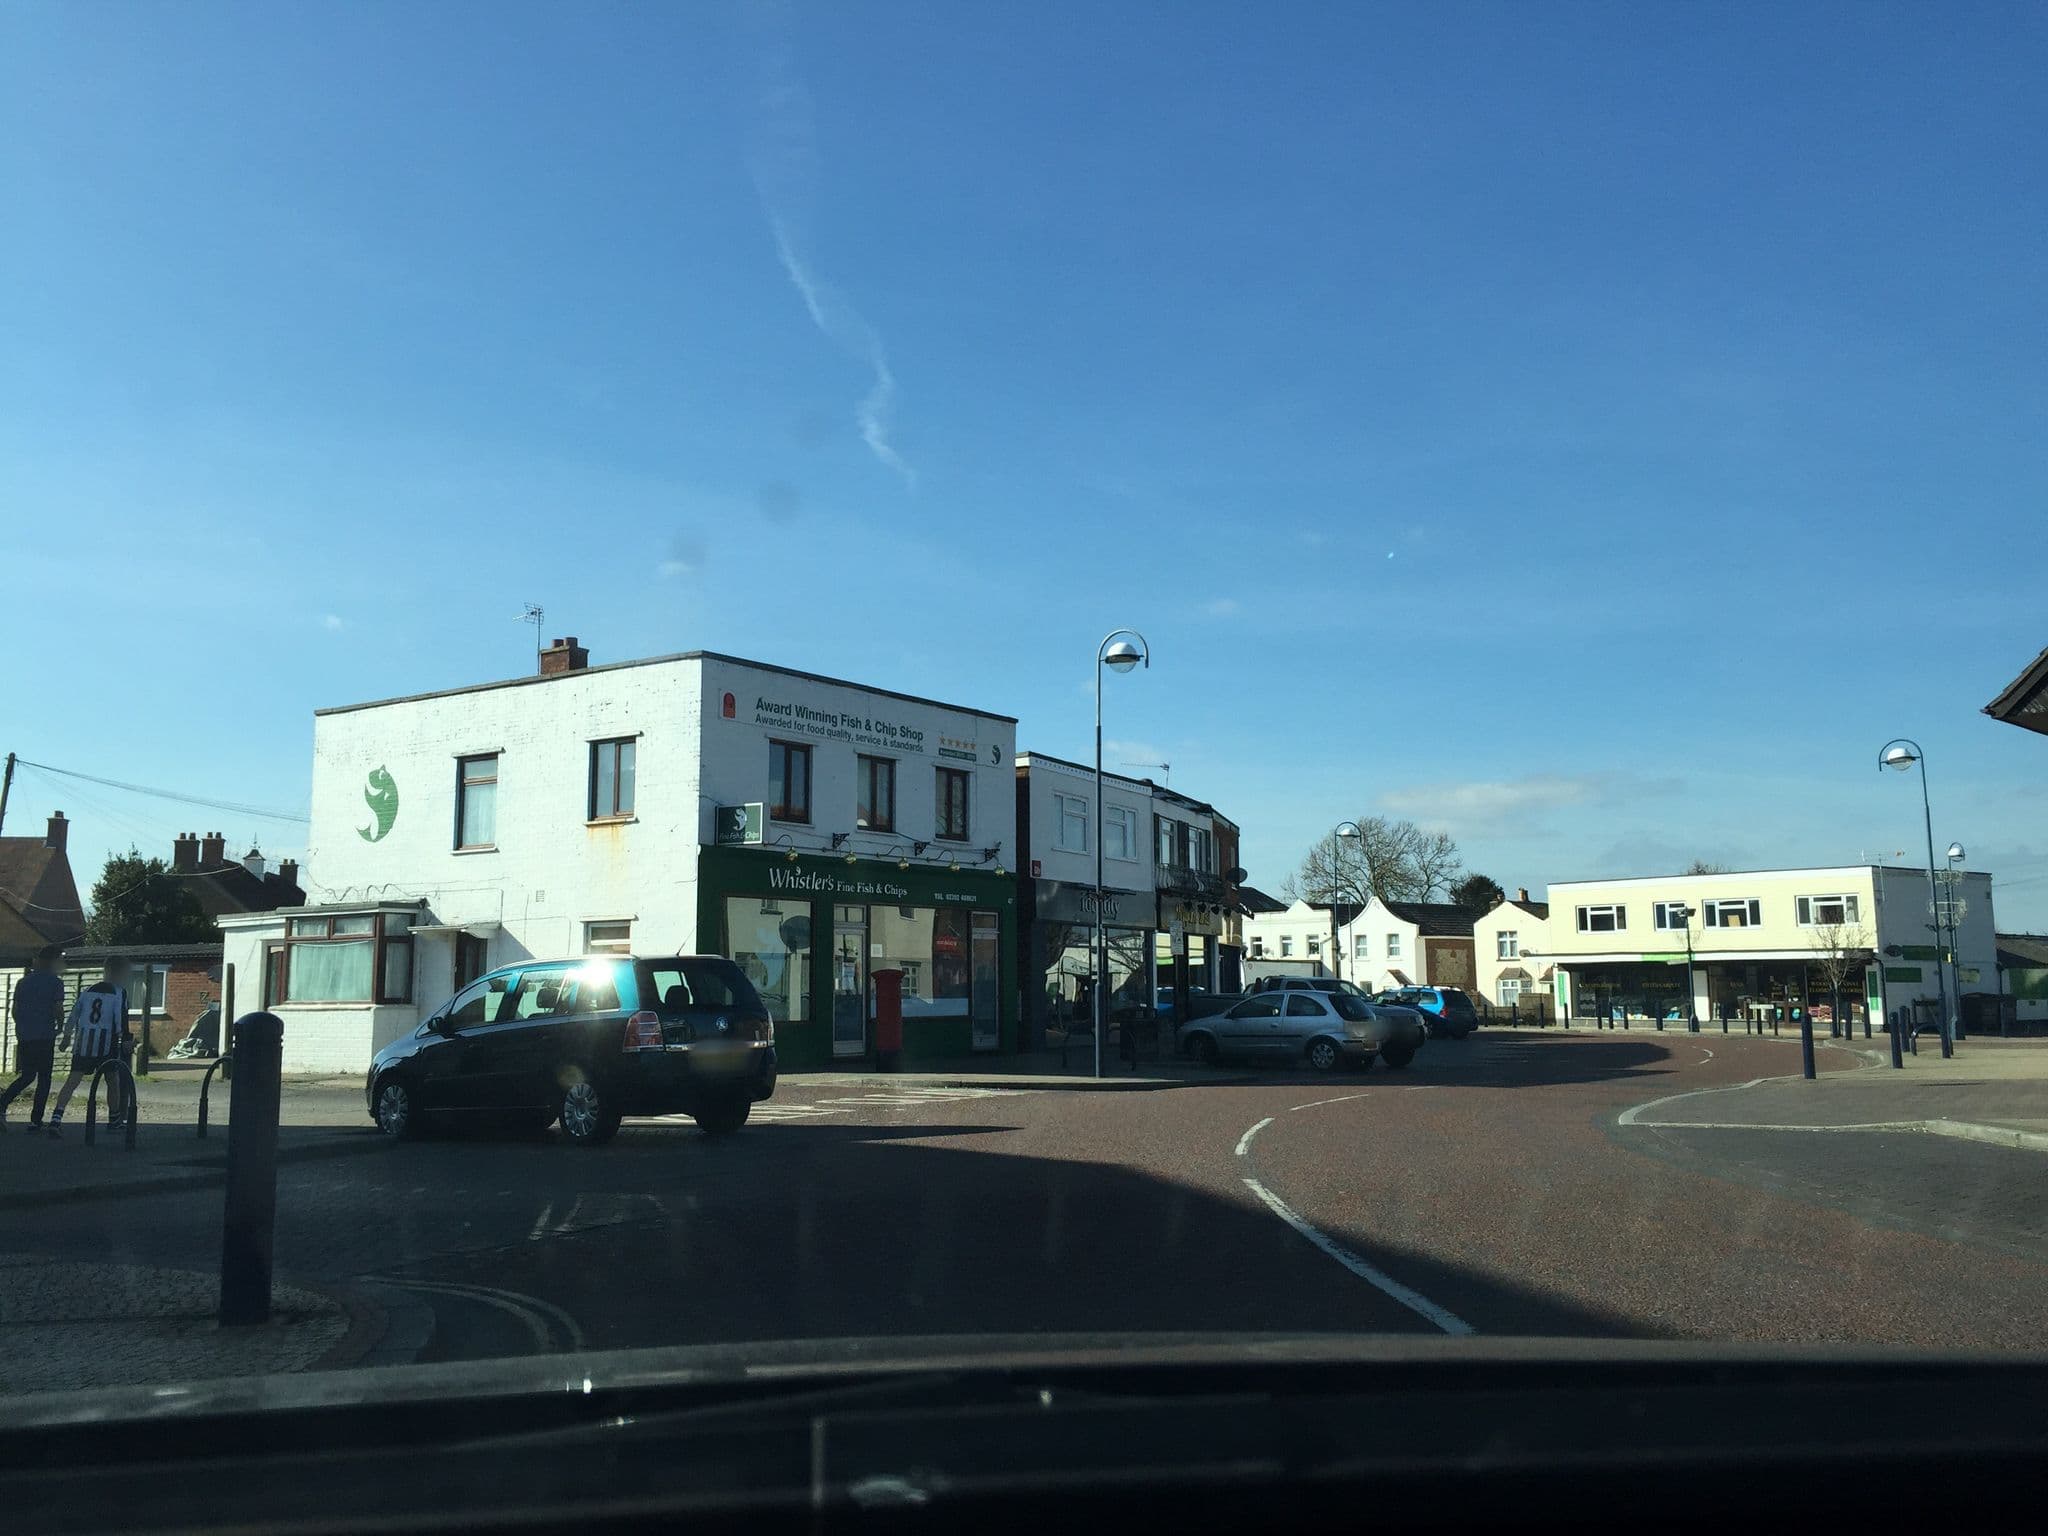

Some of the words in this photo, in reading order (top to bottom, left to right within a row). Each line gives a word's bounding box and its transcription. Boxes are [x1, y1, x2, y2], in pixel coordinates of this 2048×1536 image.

[755, 698, 792, 717] Award
[795, 704, 838, 728] Winning
[841, 713, 862, 730] Fish
[865, 719, 872, 732] &
[875, 721, 897, 738] Chip
[900, 725, 924, 742] Shop
[755, 713, 793, 729] Awarded
[794, 720, 806, 732] for
[807, 723, 825, 735] food
[826, 728, 854, 742] quality,
[855, 734, 882, 746] service
[883, 739, 888, 747] &
[890, 740, 924, 753] standards
[837, 880, 855, 892] Fine
[857, 882, 874, 894] Fish
[876, 883, 883, 894] &
[884, 883, 907, 898] Chips
[90, 998, 102, 1025] 8
